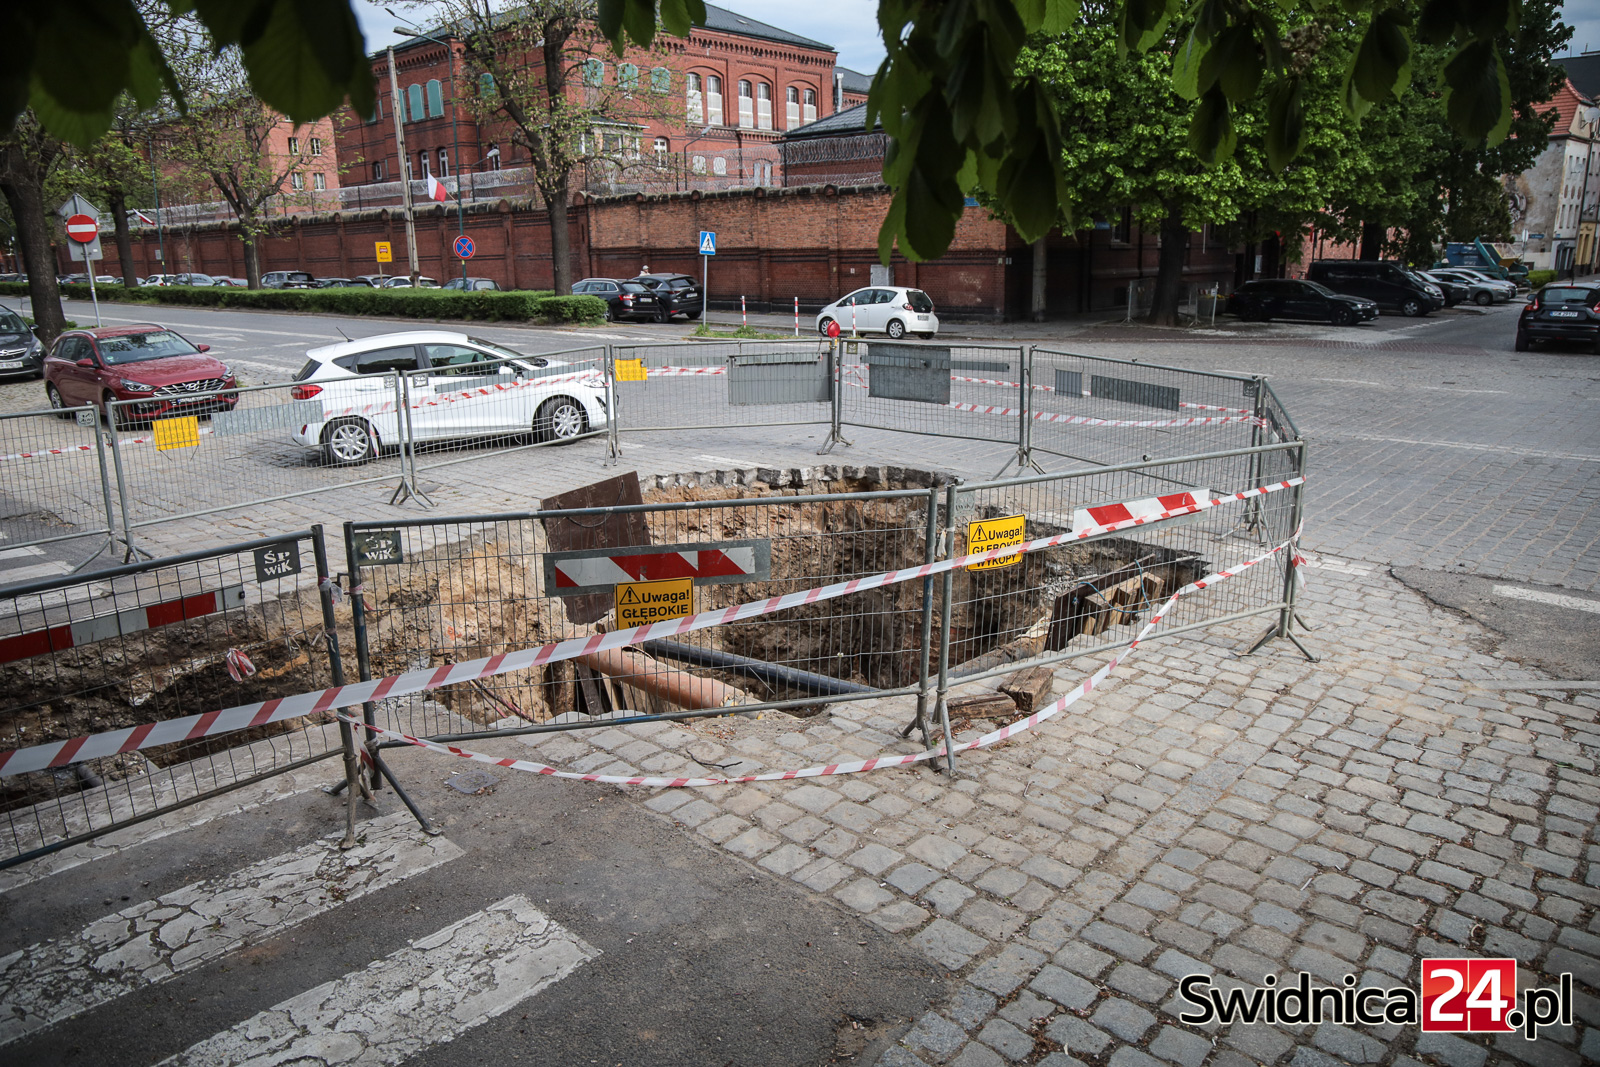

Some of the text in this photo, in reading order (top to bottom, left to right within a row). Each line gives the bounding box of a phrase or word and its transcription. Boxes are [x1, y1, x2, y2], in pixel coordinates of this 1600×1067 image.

[988, 526, 1023, 540] Uwaga!
[263, 550, 290, 564] ŚP
[263, 559, 293, 576] WiK
[642, 589, 690, 604] Uwaga!
[622, 604, 689, 620] GŁĘBOKIE
